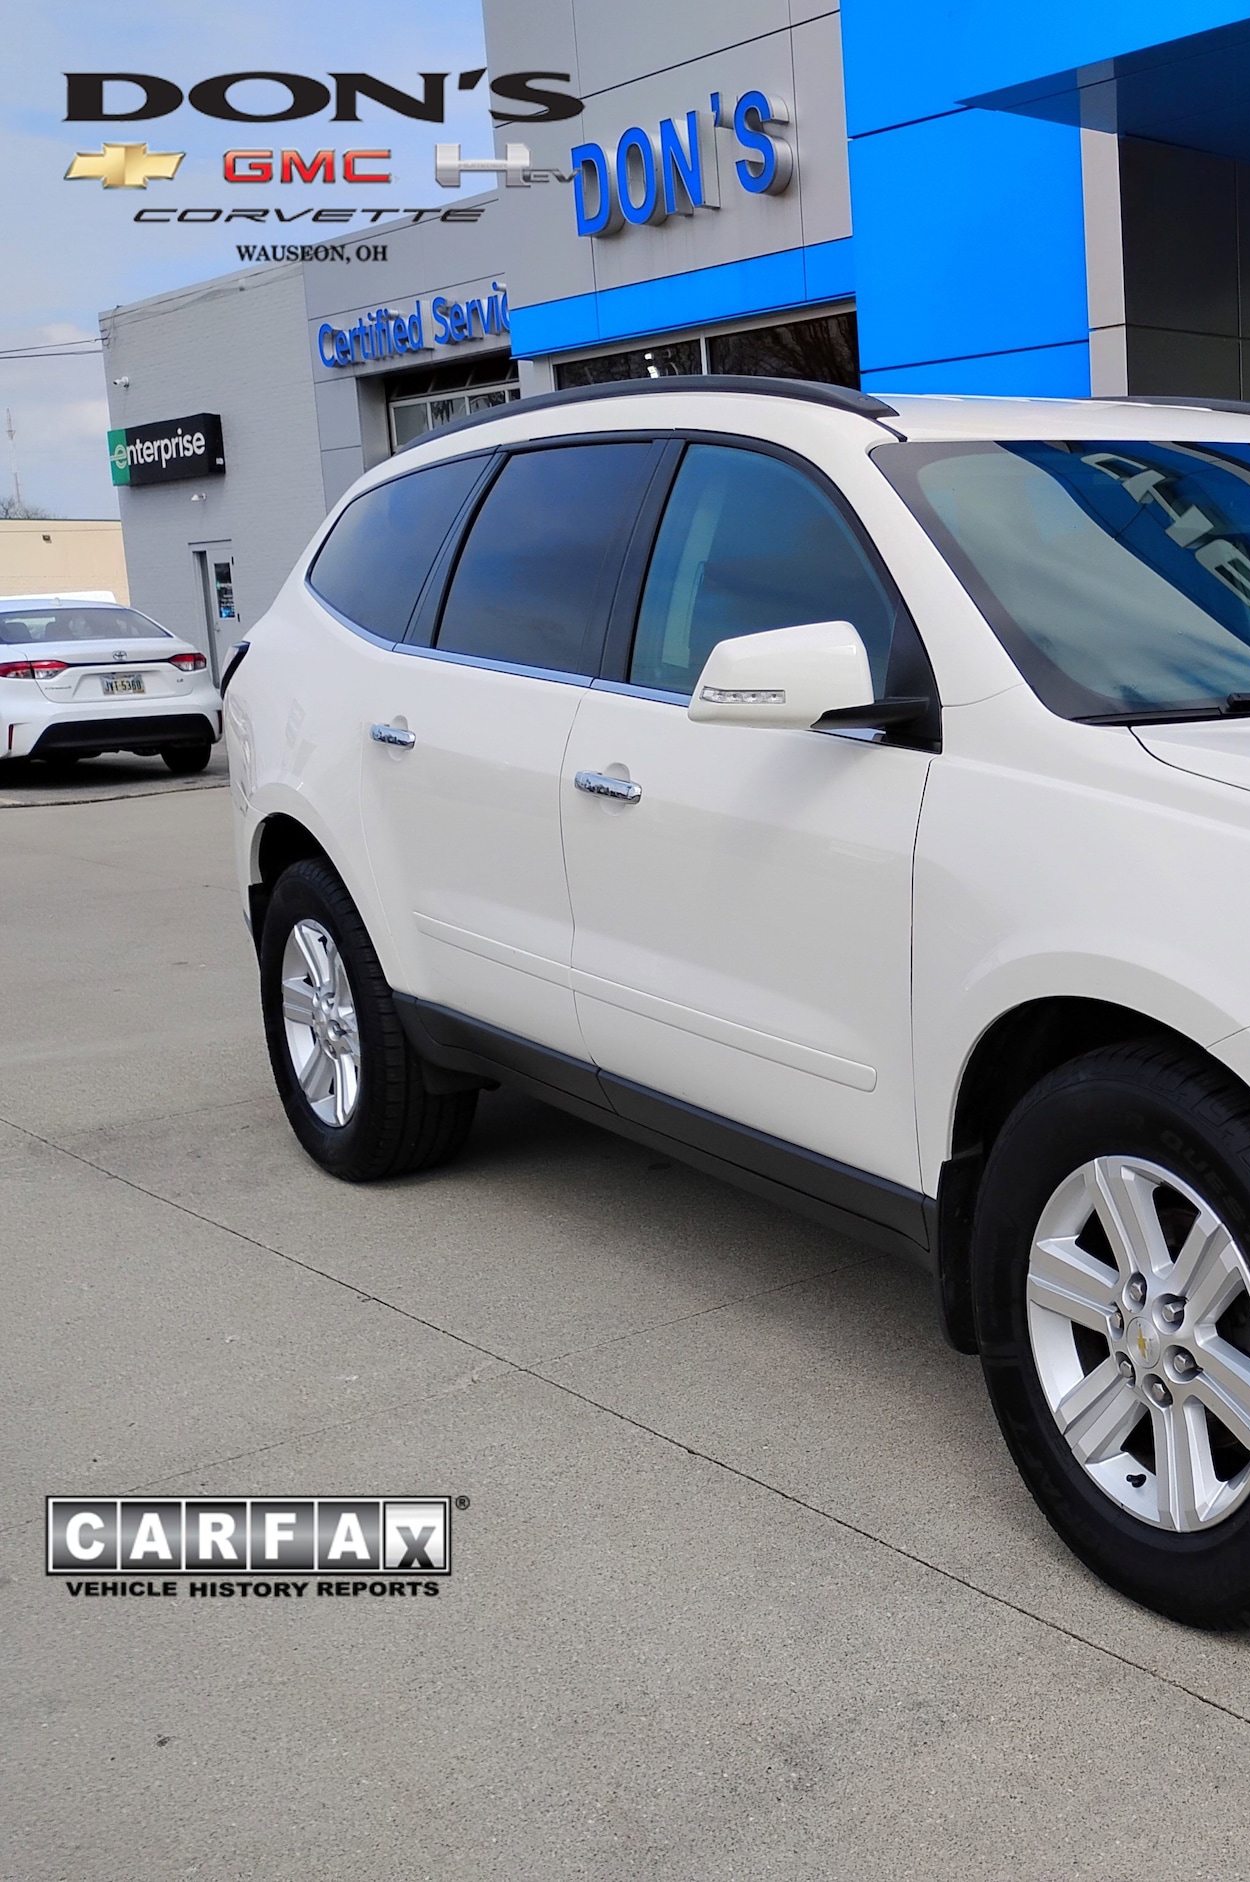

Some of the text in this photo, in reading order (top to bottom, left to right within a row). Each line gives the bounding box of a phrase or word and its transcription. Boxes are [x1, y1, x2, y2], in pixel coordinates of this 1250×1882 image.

[571, 90, 778, 237] DON'S
[318, 281, 511, 368] Certified Servic
[111, 428, 206, 469] enterprise
